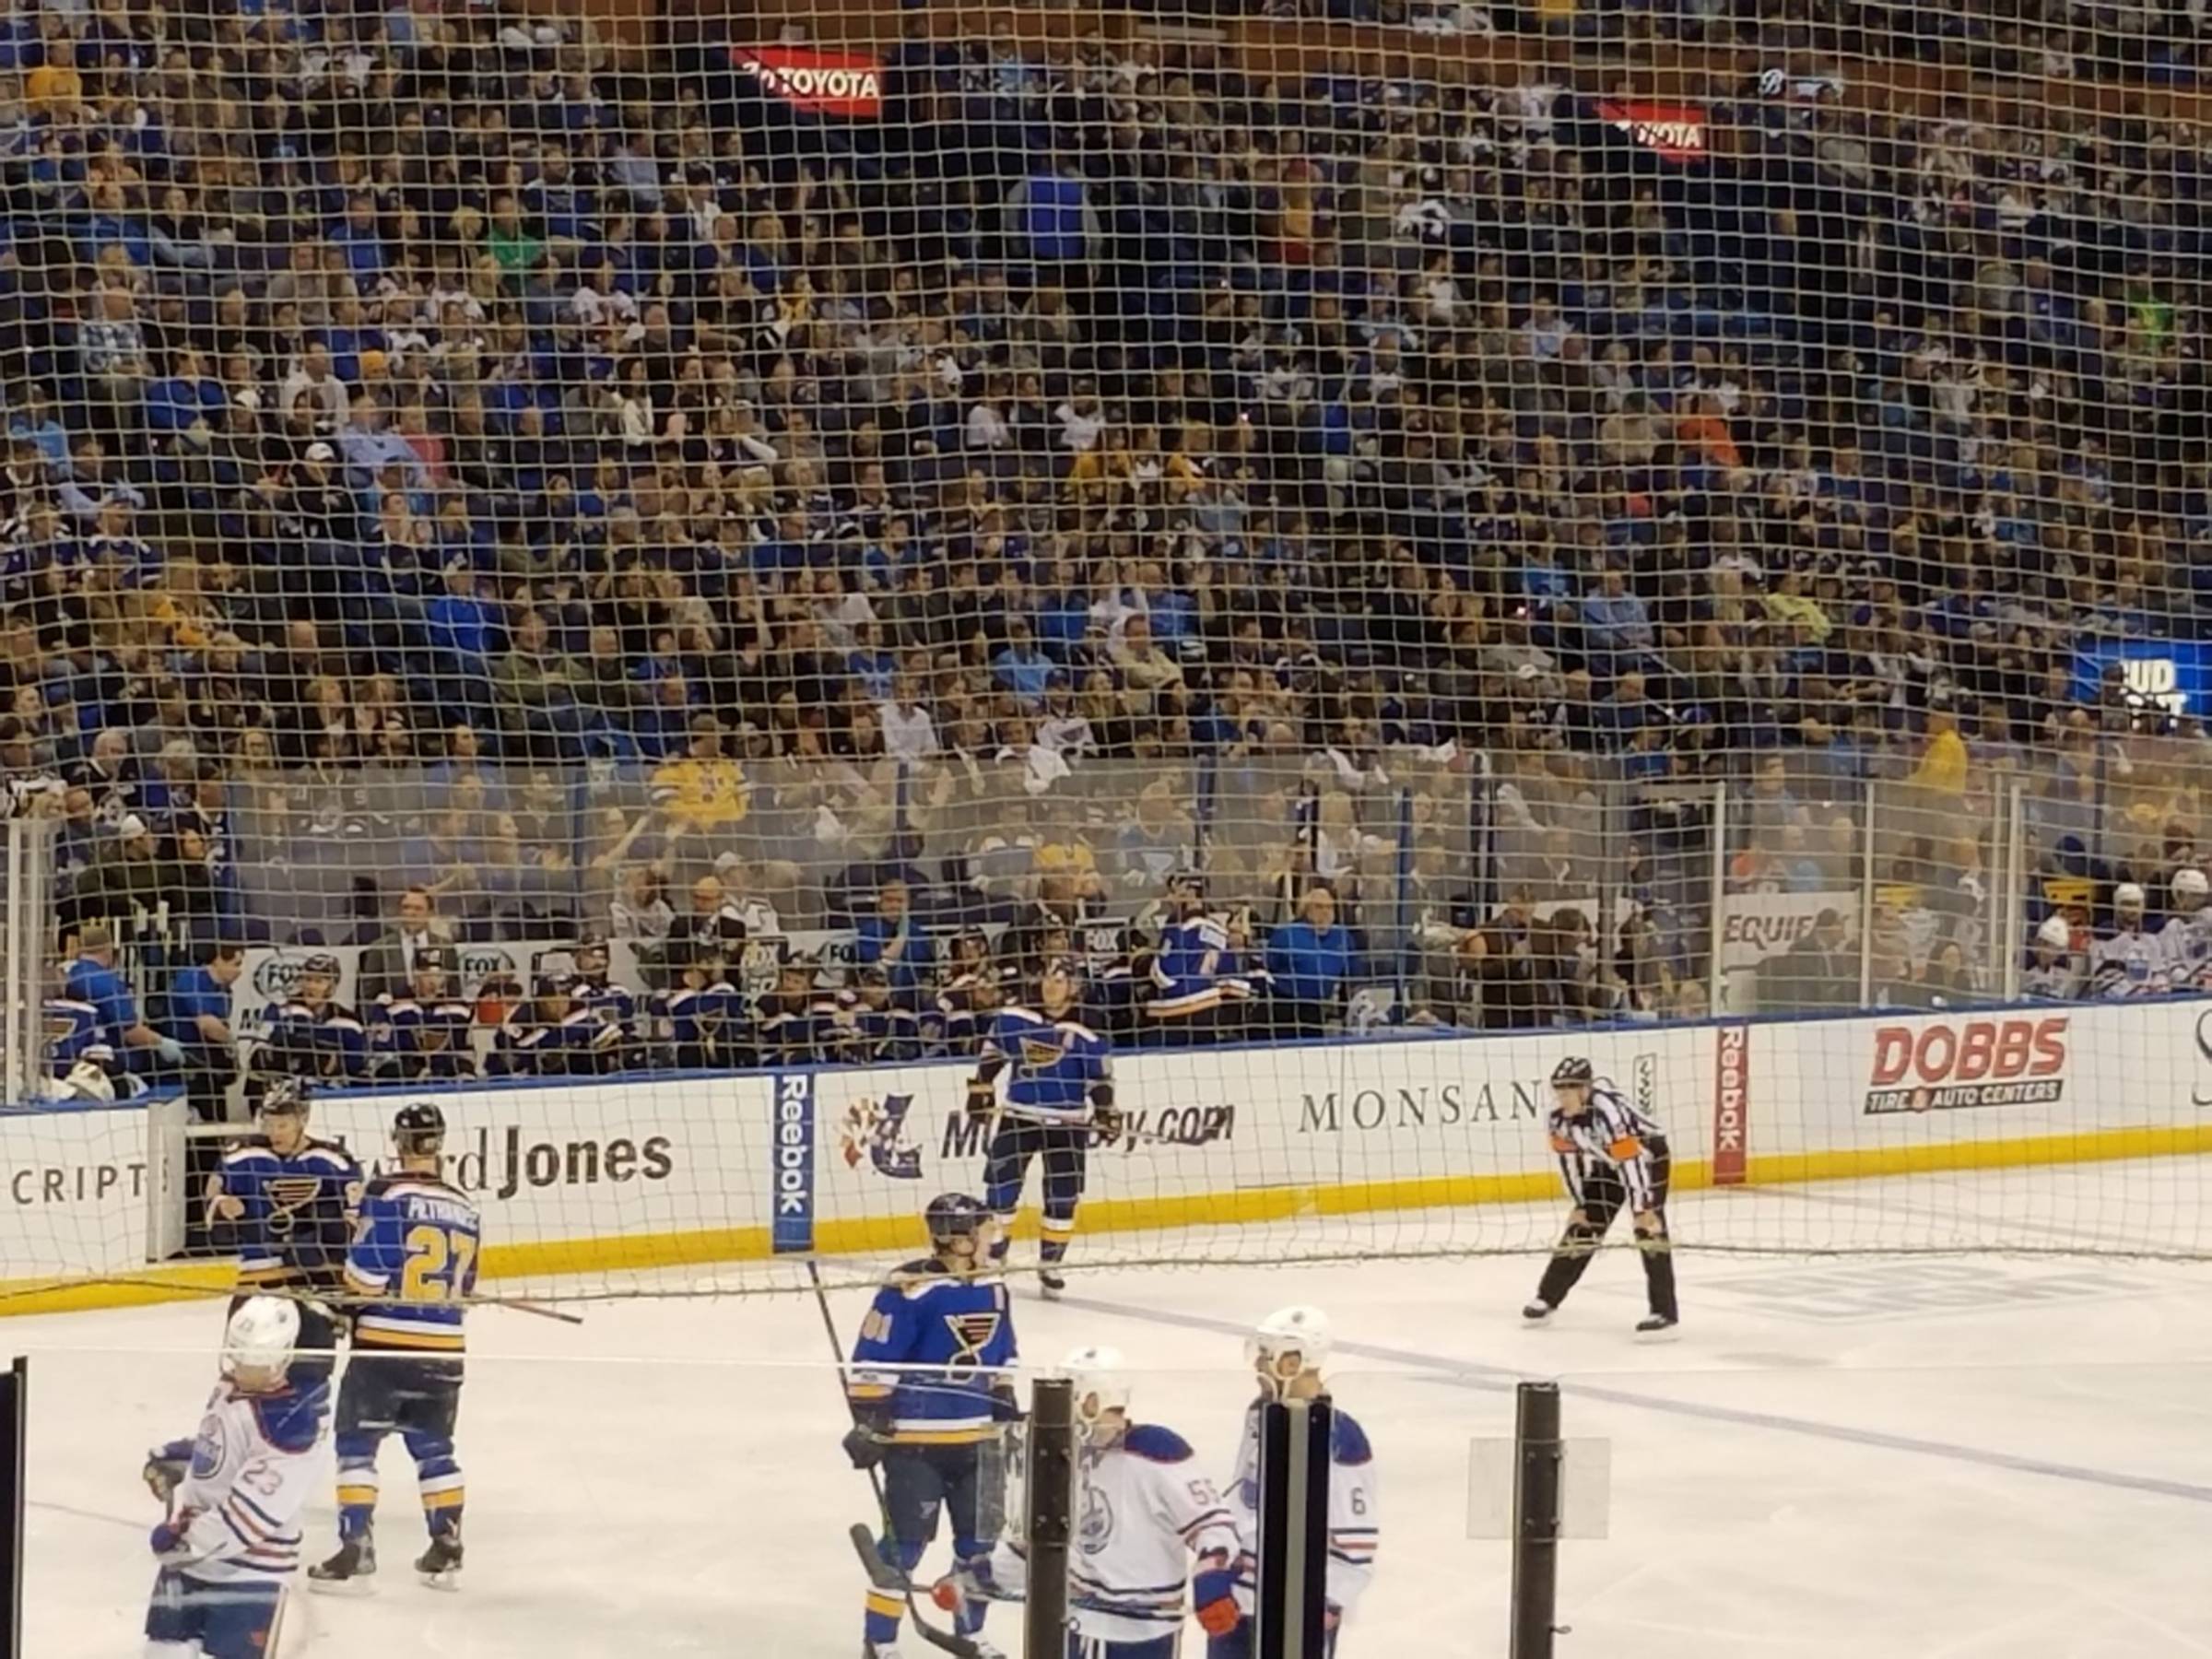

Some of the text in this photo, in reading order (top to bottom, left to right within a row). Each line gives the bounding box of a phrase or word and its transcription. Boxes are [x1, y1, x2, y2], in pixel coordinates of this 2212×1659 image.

[777, 66, 879, 98] TOYOTA
[464, 957, 500, 976] FOX
[1871, 1018, 2069, 1087] DOBBS
[1298, 1079, 1542, 1134] MONSAN
[1719, 1027, 1745, 1151] Reebok
[1869, 1092, 1908, 1112] TIRE
[1932, 1087, 1977, 1106] AUTO
[1982, 1081, 2059, 1105] CENTERS
[498, 1124, 673, 1199] Jones
[781, 1074, 808, 1215] Reebok
[401, 1225, 477, 1299] 27
[1350, 1487, 1375, 1515] 6
